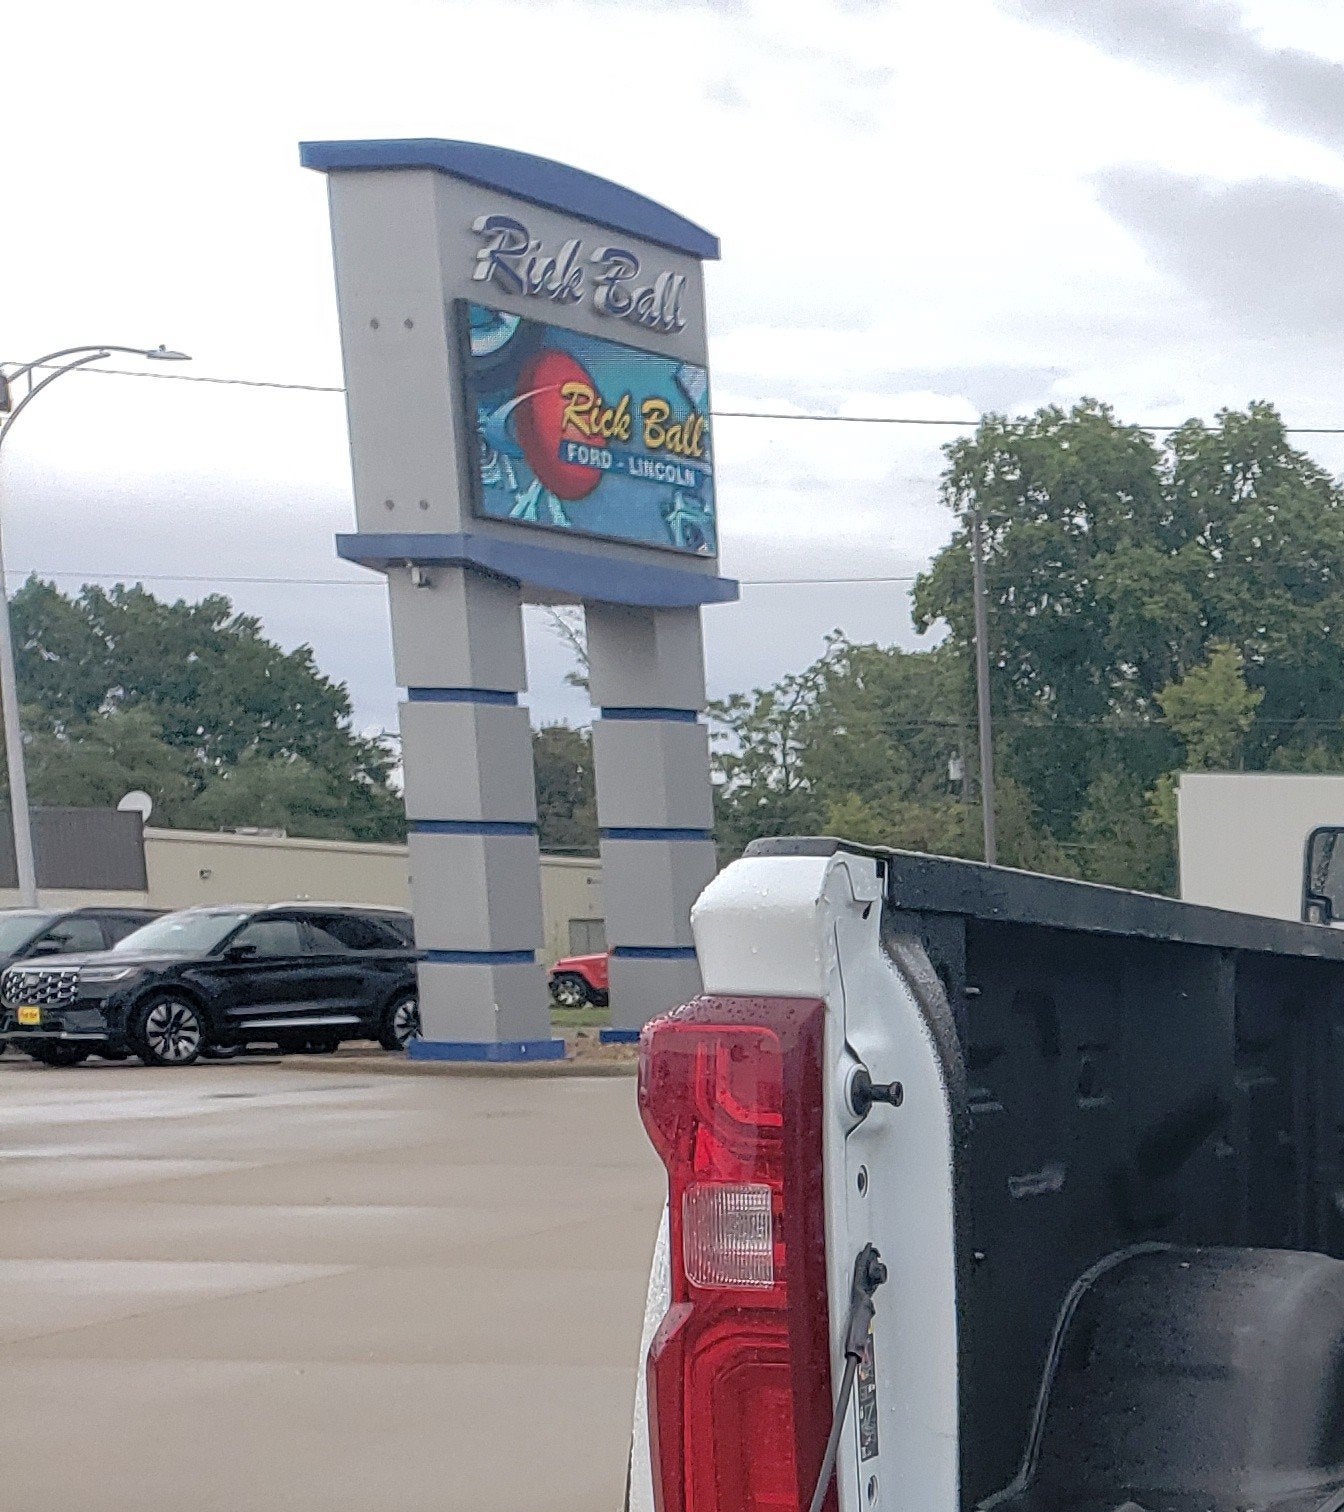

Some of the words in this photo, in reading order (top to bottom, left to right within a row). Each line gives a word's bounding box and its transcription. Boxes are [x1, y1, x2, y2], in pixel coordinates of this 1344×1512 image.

[472, 214, 585, 304] Rick
[590, 247, 687, 334] Ball
[560, 381, 632, 441] Rick
[641, 397, 705, 457] Ball
[567, 443, 613, 469] FORD
[628, 456, 695, 487] LINCOLN
